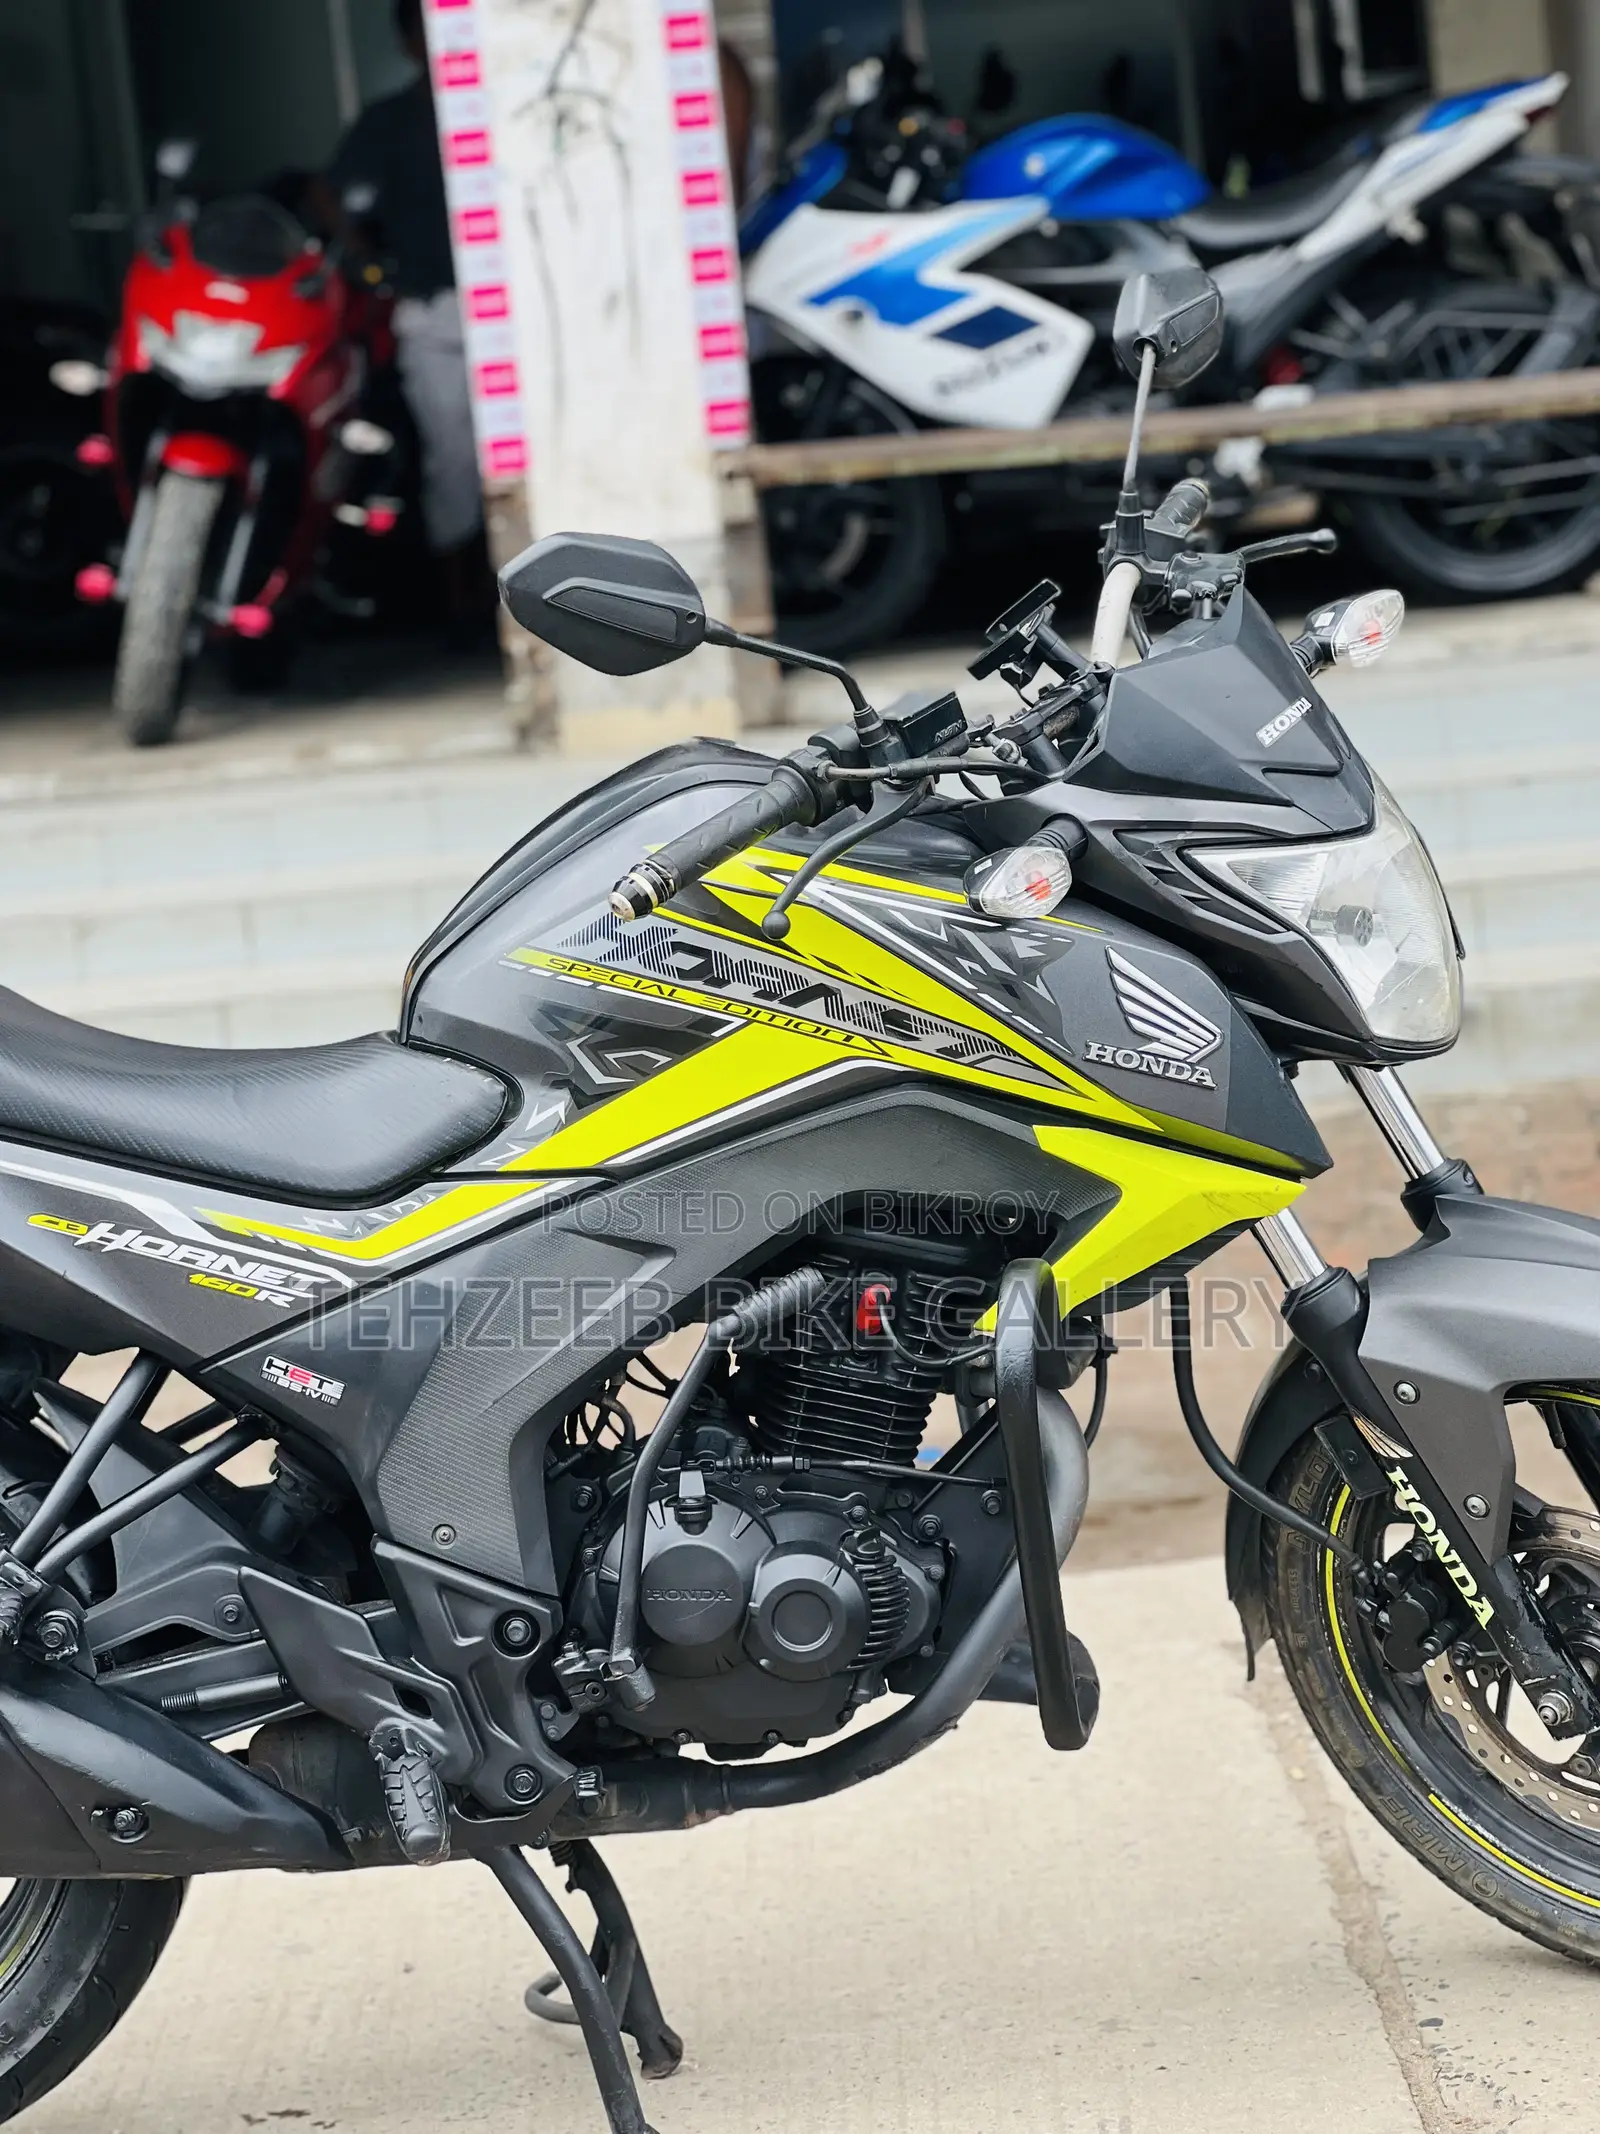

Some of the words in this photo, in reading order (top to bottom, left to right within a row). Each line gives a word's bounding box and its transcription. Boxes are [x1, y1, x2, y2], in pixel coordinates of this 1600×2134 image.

[549, 956, 686, 1001] SPECIAL
[699, 996, 854, 1043] EDITION
[1083, 1040, 1218, 1090] HONDA
[73, 1222, 332, 1292] HORNET
[188, 1273, 296, 1308] 160R
[265, 1358, 334, 1390] HET
[1386, 1466, 1495, 1630] HONDA
[646, 1588, 734, 1602] HONDA
